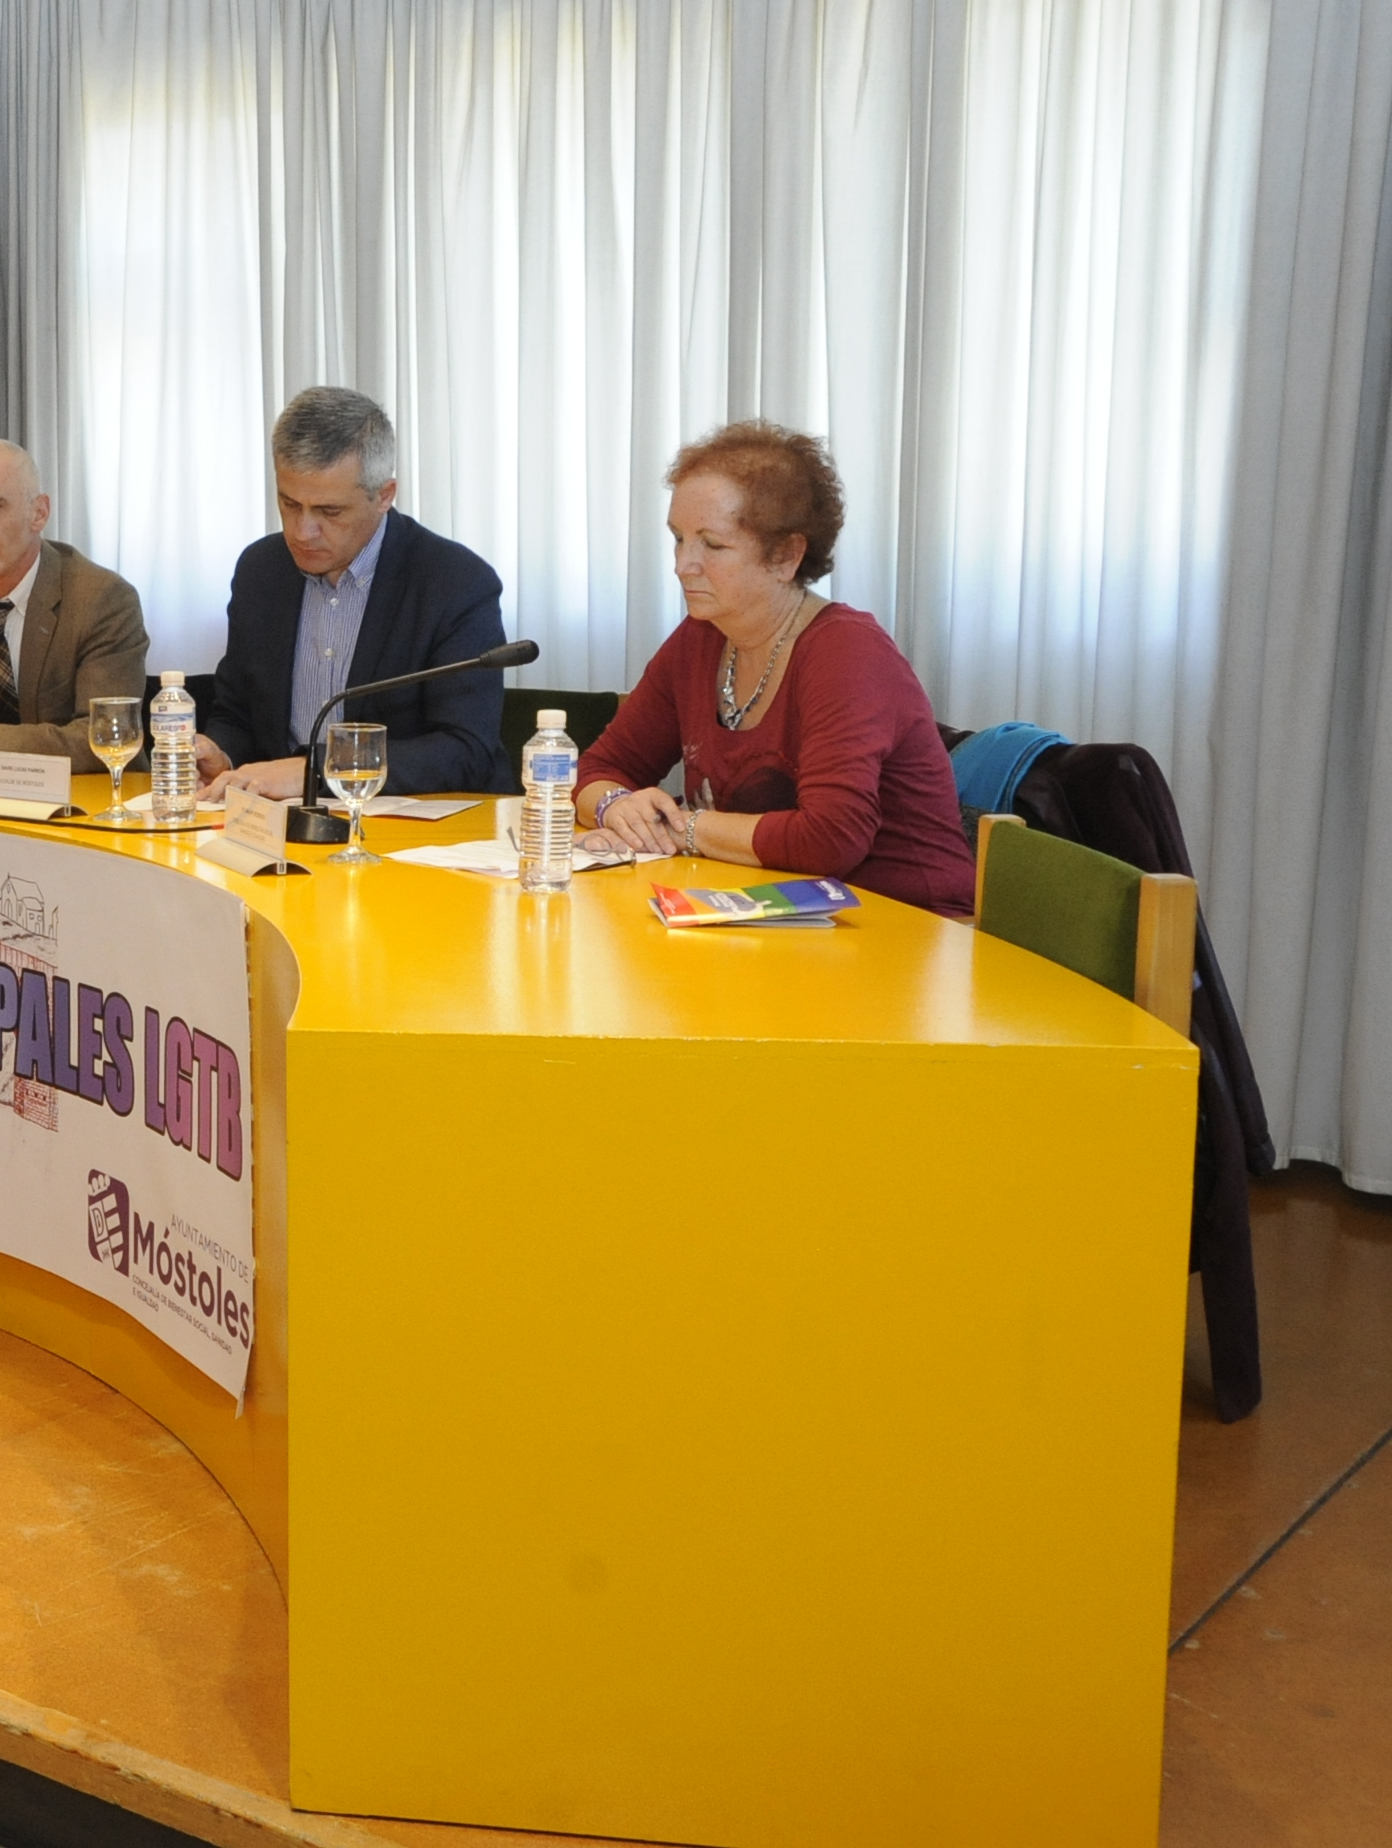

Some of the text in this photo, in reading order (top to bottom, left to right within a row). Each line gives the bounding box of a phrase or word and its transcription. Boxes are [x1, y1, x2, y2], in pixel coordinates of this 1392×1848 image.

[144, 1006, 242, 1182] LGTB
[133, 1211, 250, 1350] Móstoles
[171, 1213, 249, 1284] AYUNTAMIENTO DE
